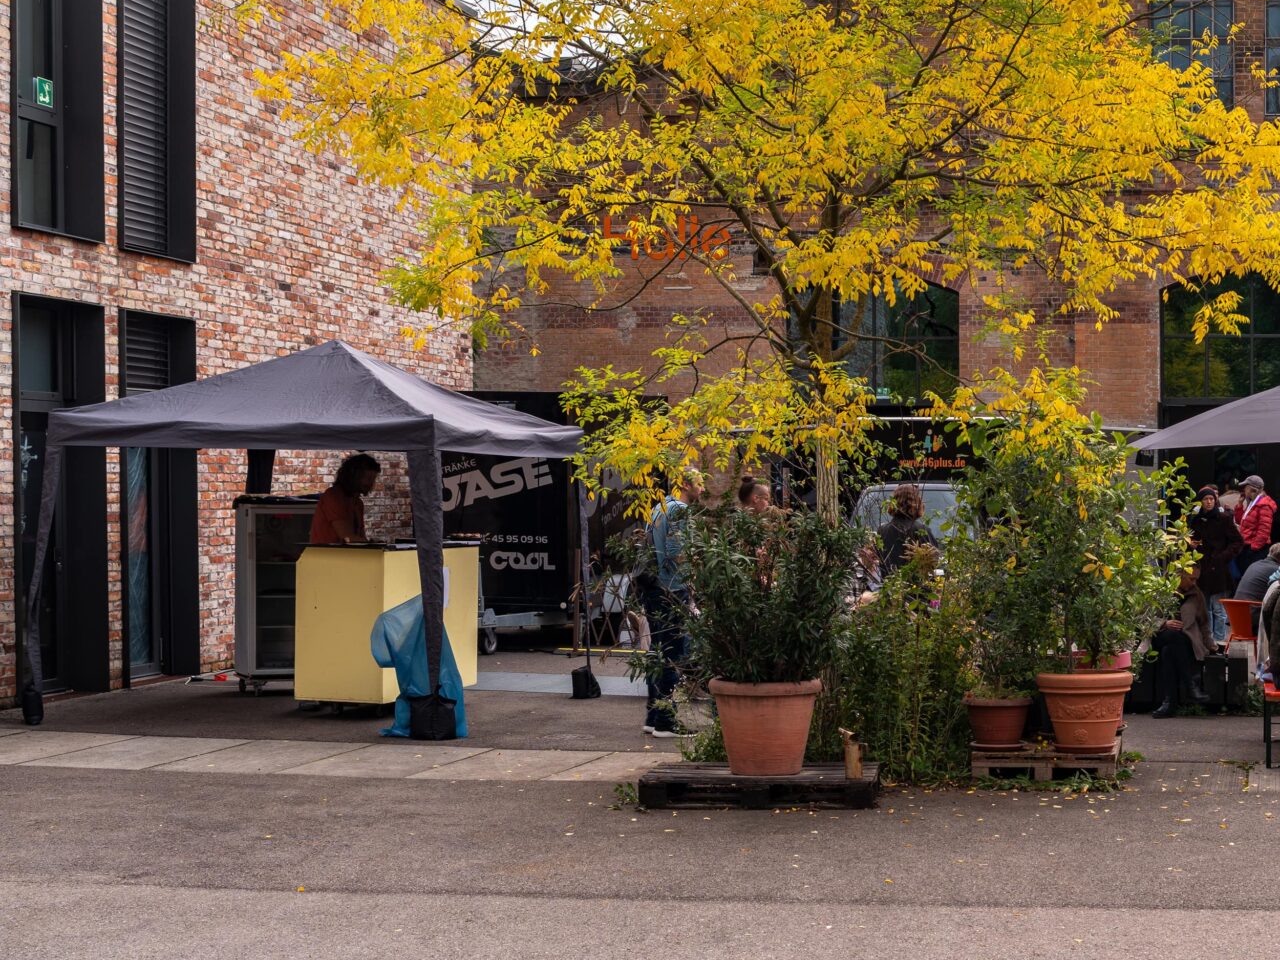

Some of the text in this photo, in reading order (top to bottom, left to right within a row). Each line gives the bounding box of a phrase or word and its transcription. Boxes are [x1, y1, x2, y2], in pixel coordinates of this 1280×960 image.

[603, 215, 732, 261] Halle
[505, 534, 519, 543] 95
[520, 534, 534, 544] 09
[535, 535, 549, 544] 96
[489, 550, 556, 571] COOL
